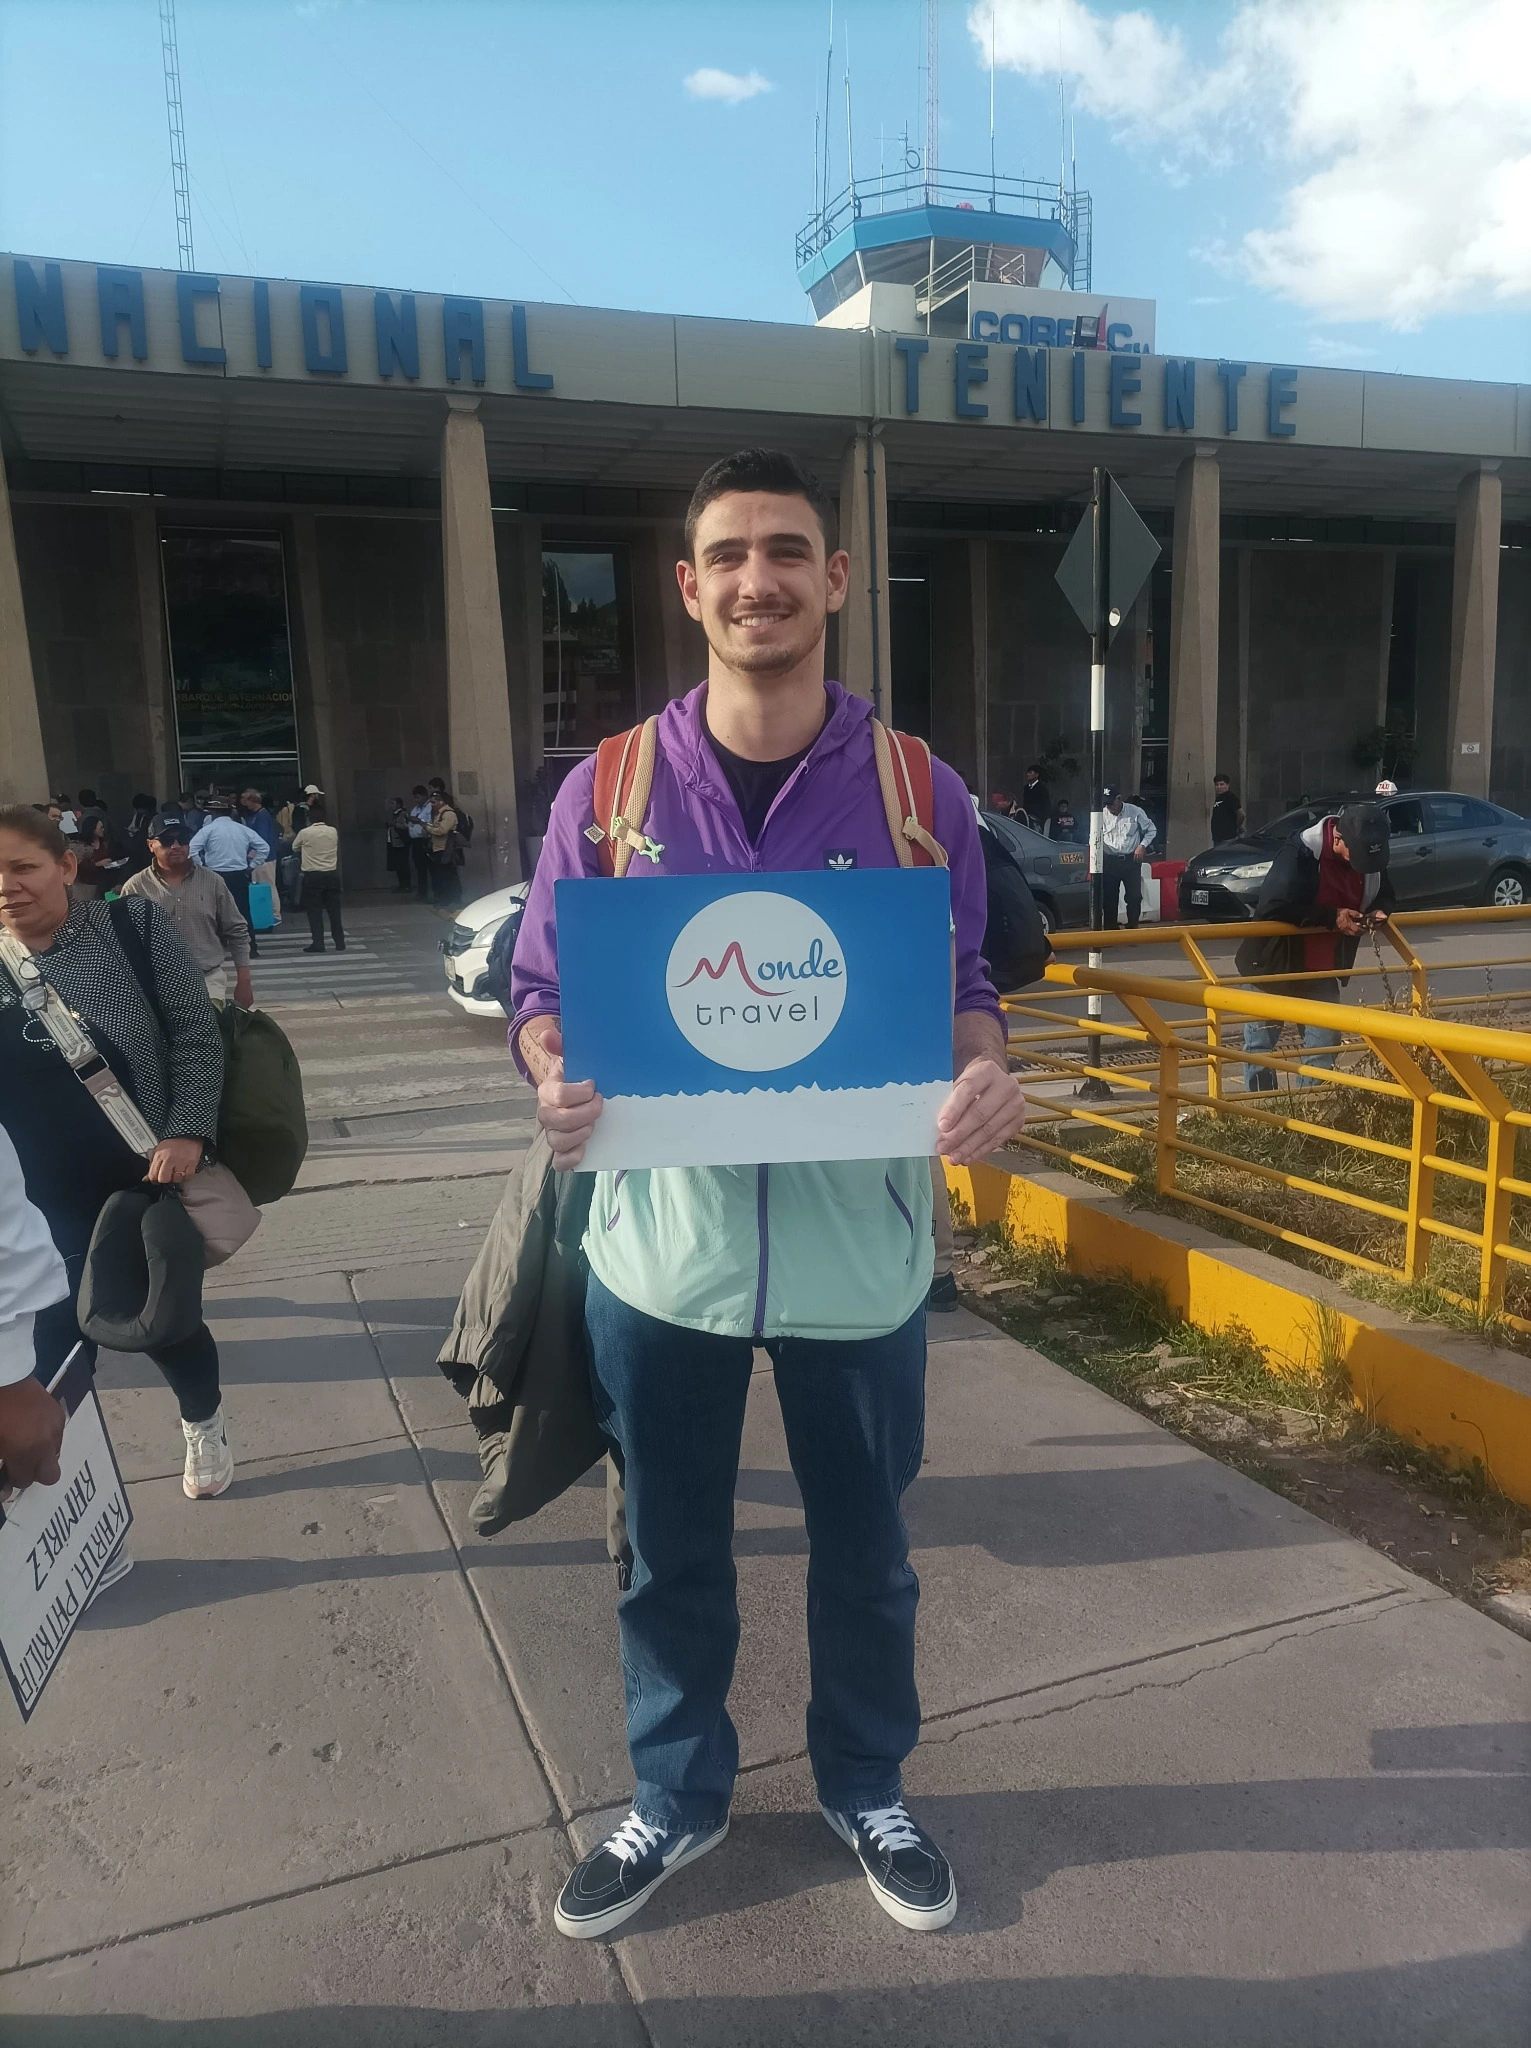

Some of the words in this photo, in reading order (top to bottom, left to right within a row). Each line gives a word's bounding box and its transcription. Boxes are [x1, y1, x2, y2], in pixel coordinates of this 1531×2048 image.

[13, 259, 555, 391] NACIONAL
[895, 337, 1298, 437] TENIENTE
[671, 938, 843, 997] Monde
[696, 995, 819, 1026] travel
